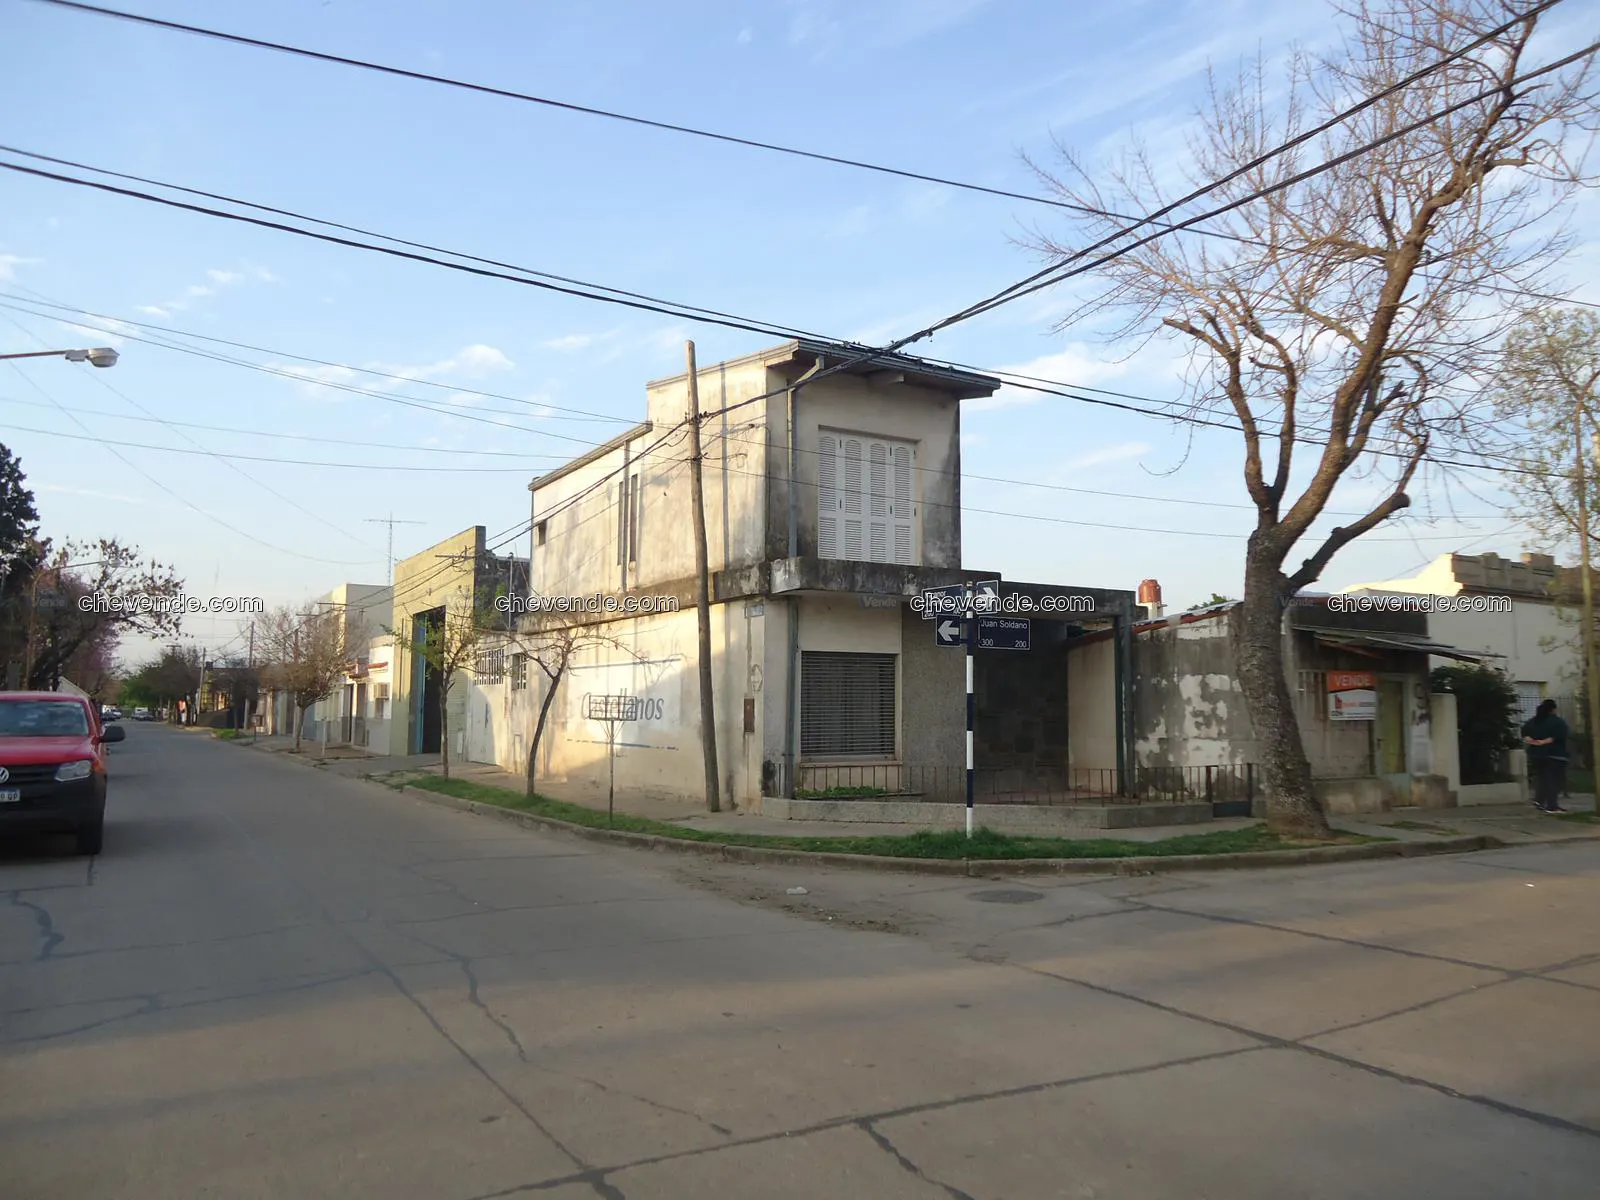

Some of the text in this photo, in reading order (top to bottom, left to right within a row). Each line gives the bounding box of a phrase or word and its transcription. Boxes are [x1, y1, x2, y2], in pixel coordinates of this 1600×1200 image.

[981, 619, 1028, 630] Juan Soldano
[981, 638, 1027, 648] 300 200
[1334, 674, 1372, 687] VENDE
